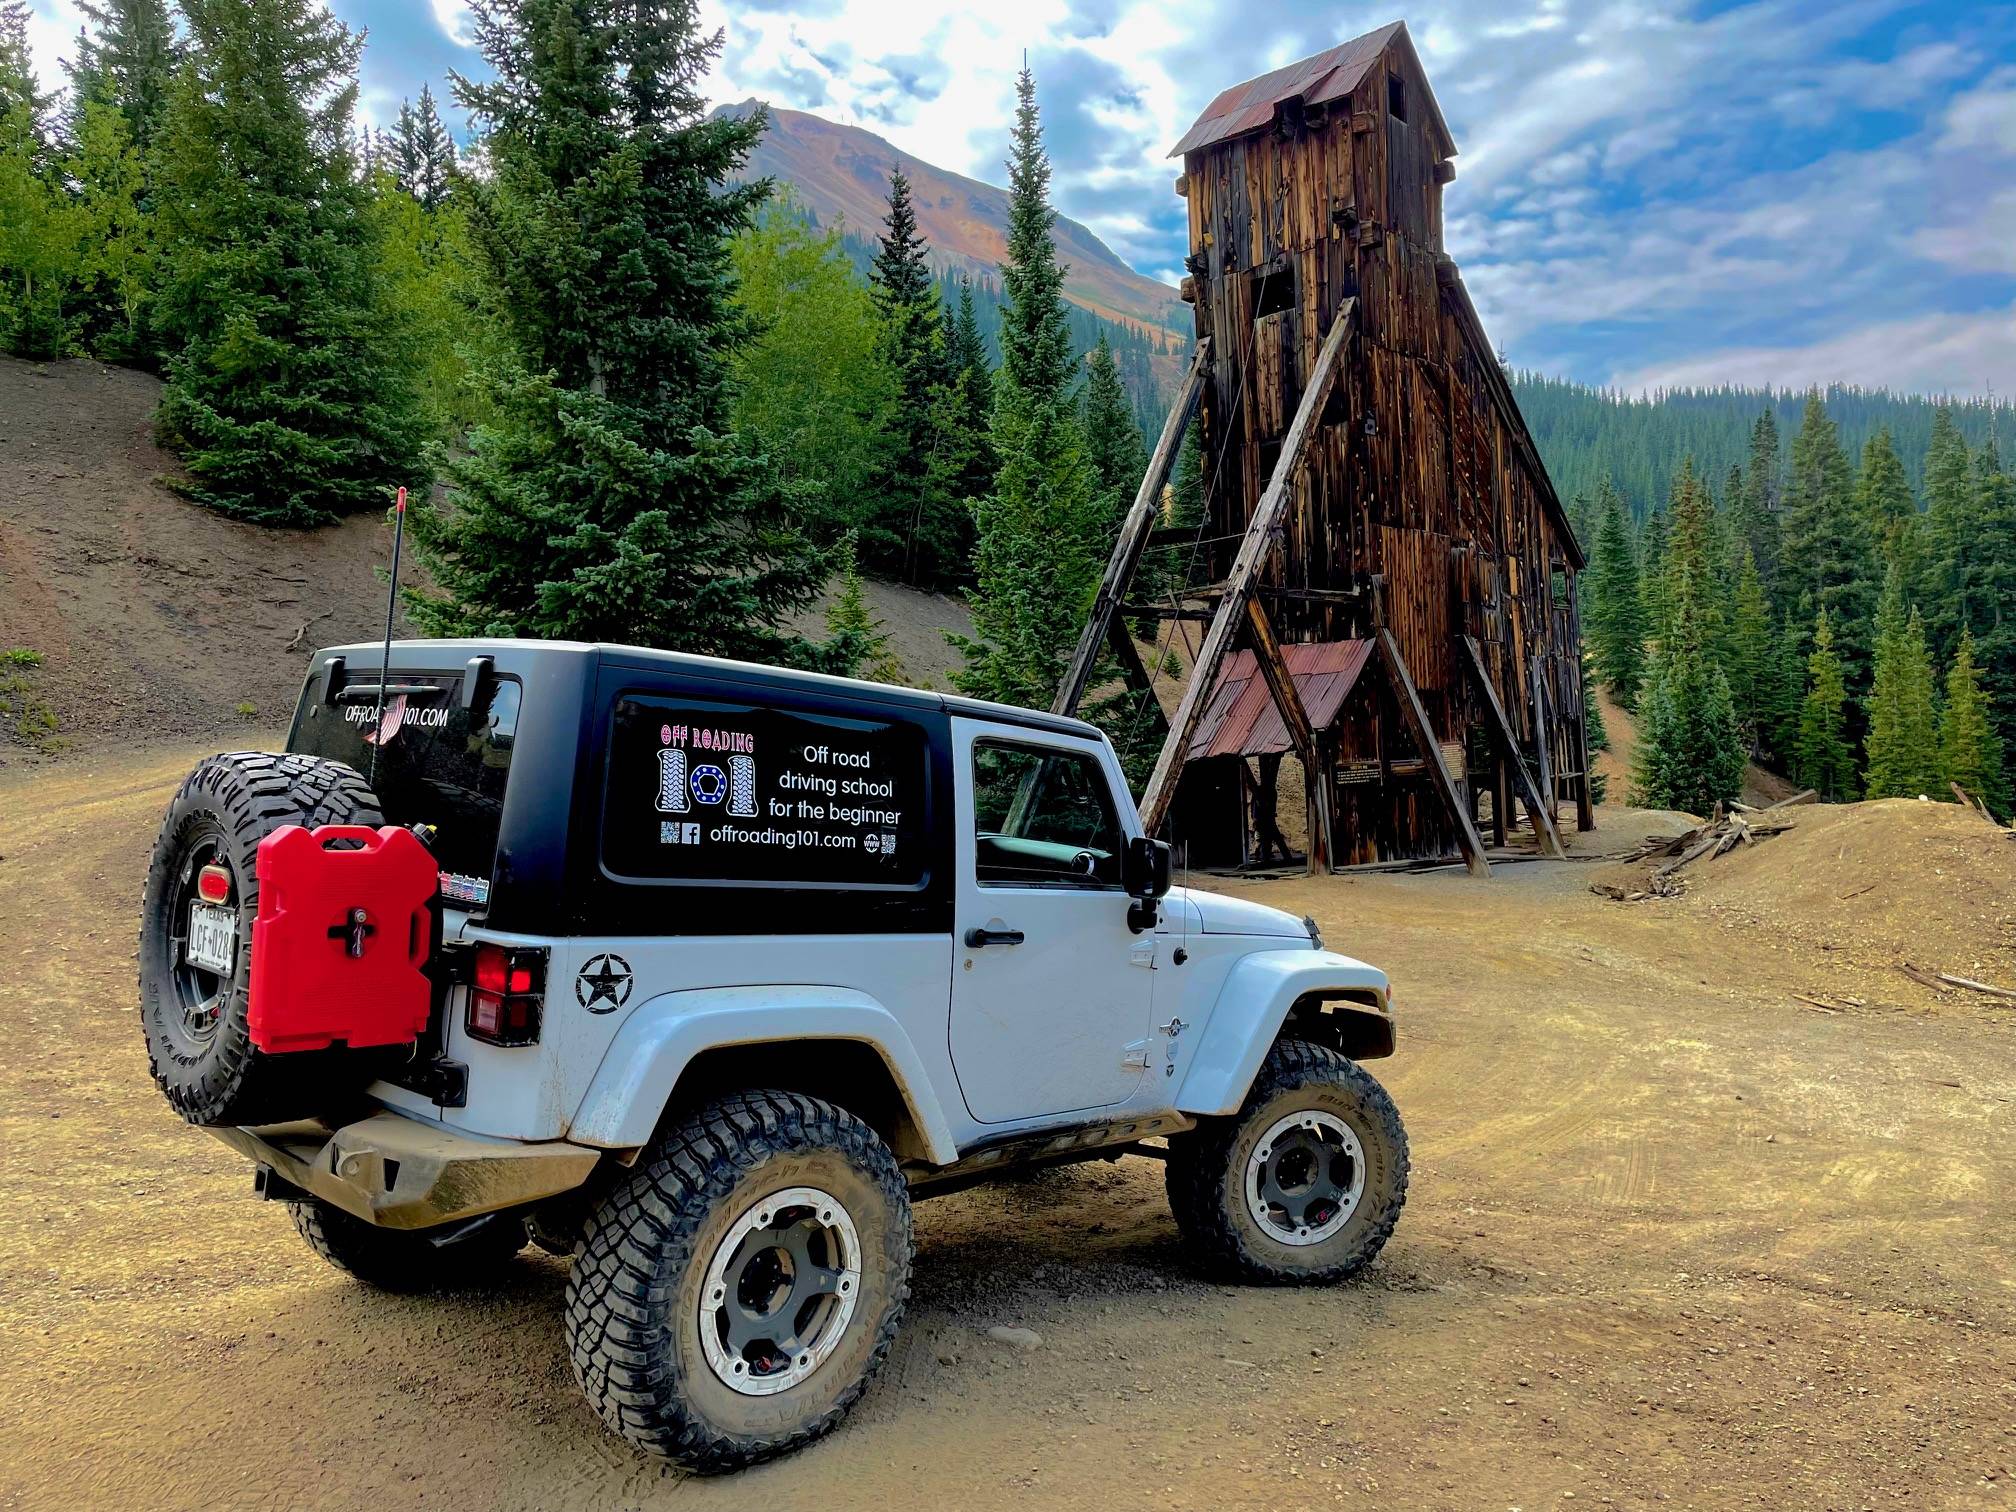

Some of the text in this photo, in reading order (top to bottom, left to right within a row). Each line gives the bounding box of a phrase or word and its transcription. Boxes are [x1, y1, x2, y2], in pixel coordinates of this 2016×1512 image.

[345, 704, 448, 727] OFFROA101.COM
[660, 724, 754, 753] OFF ROADING
[803, 745, 870, 768] Off road
[655, 748, 759, 817] 101
[779, 770, 892, 798] driving school
[768, 797, 901, 826] for the beginner
[710, 824, 856, 849] offroading101.com
